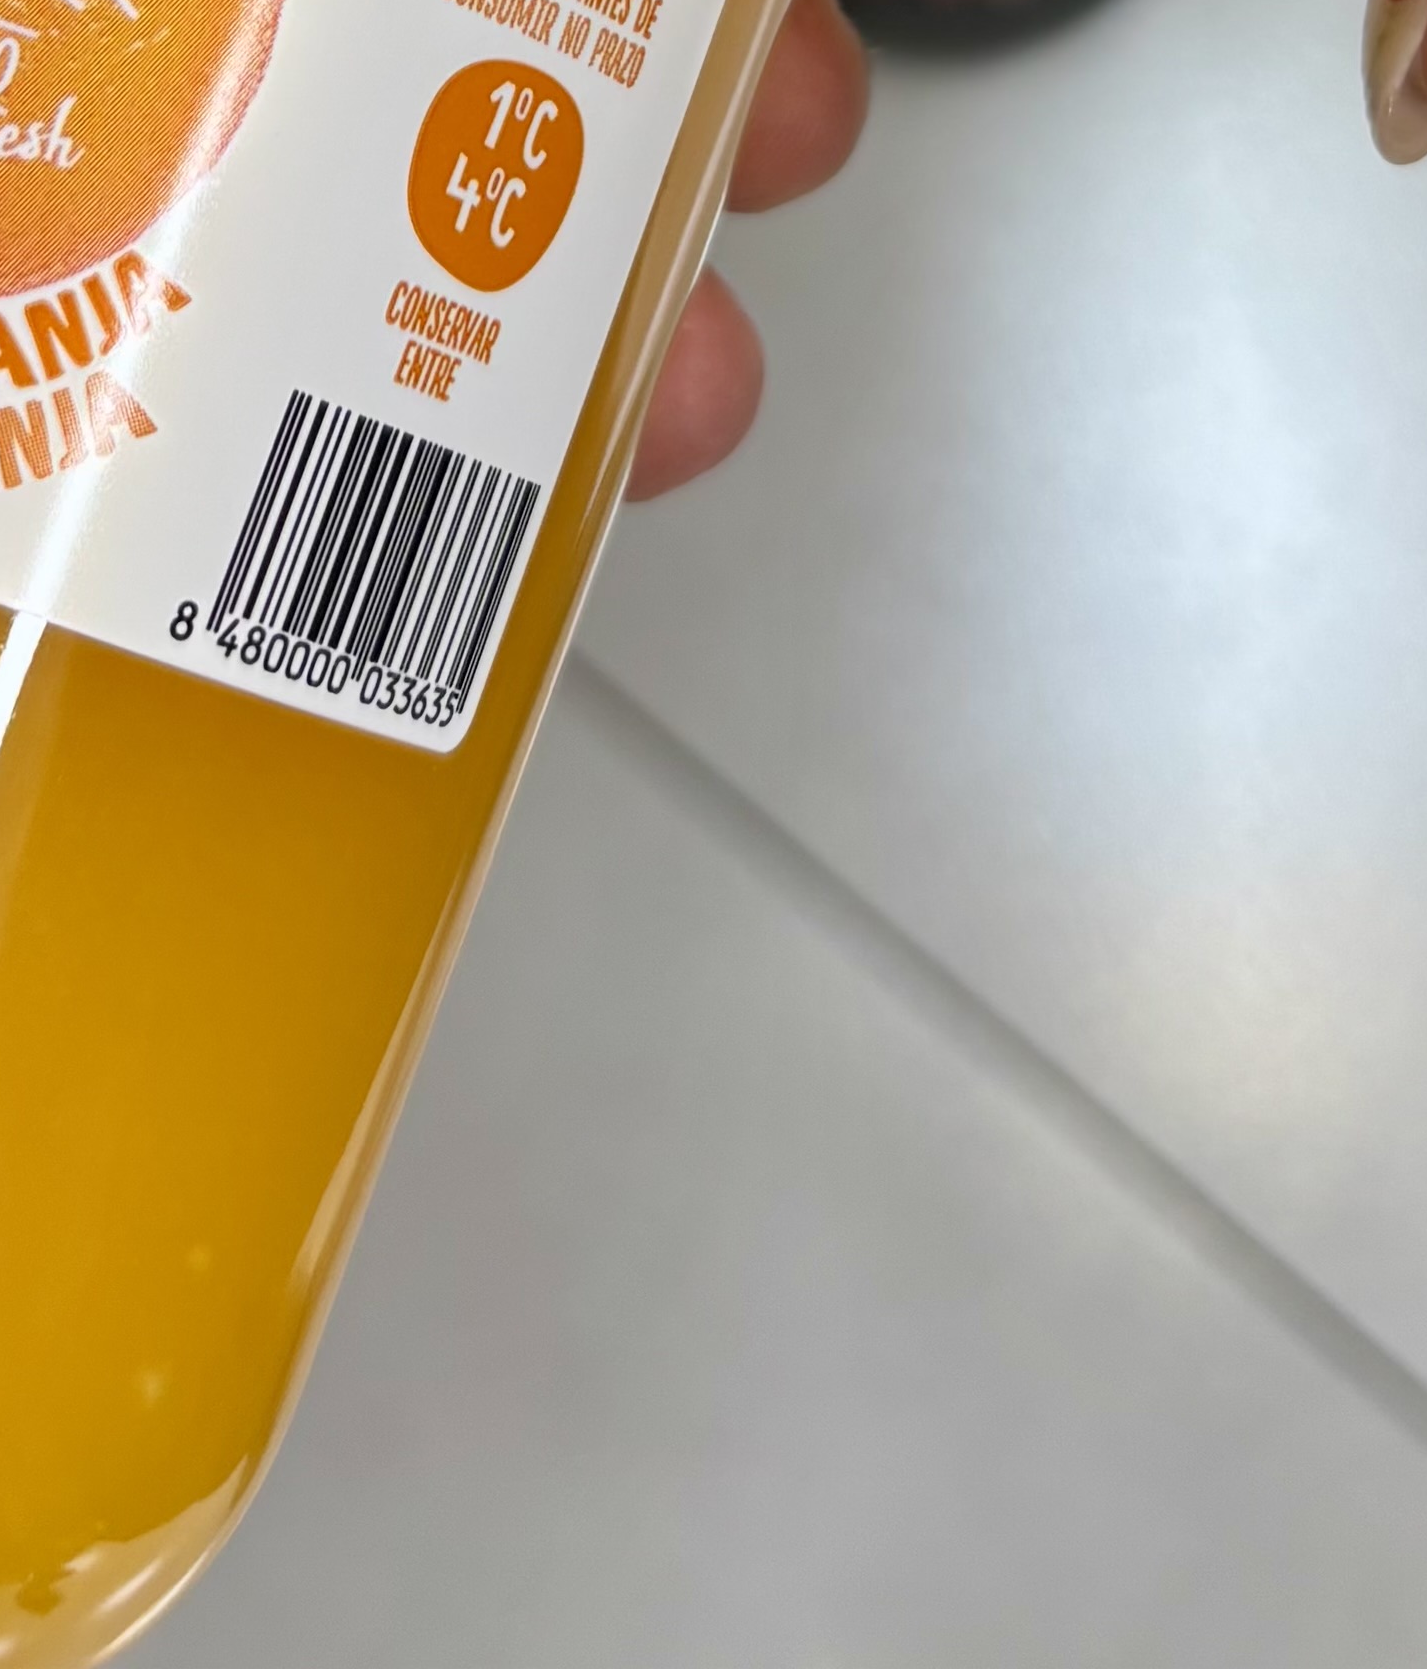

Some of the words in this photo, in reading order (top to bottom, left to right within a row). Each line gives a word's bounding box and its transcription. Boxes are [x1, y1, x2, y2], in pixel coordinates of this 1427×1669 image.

[557, 9, 592, 61] NO
[587, 26, 648, 90] PRAZO
[384, 278, 503, 367] CONSERVAR
[393, 338, 463, 404] ENTRE
[168, 599, 200, 642] 8
